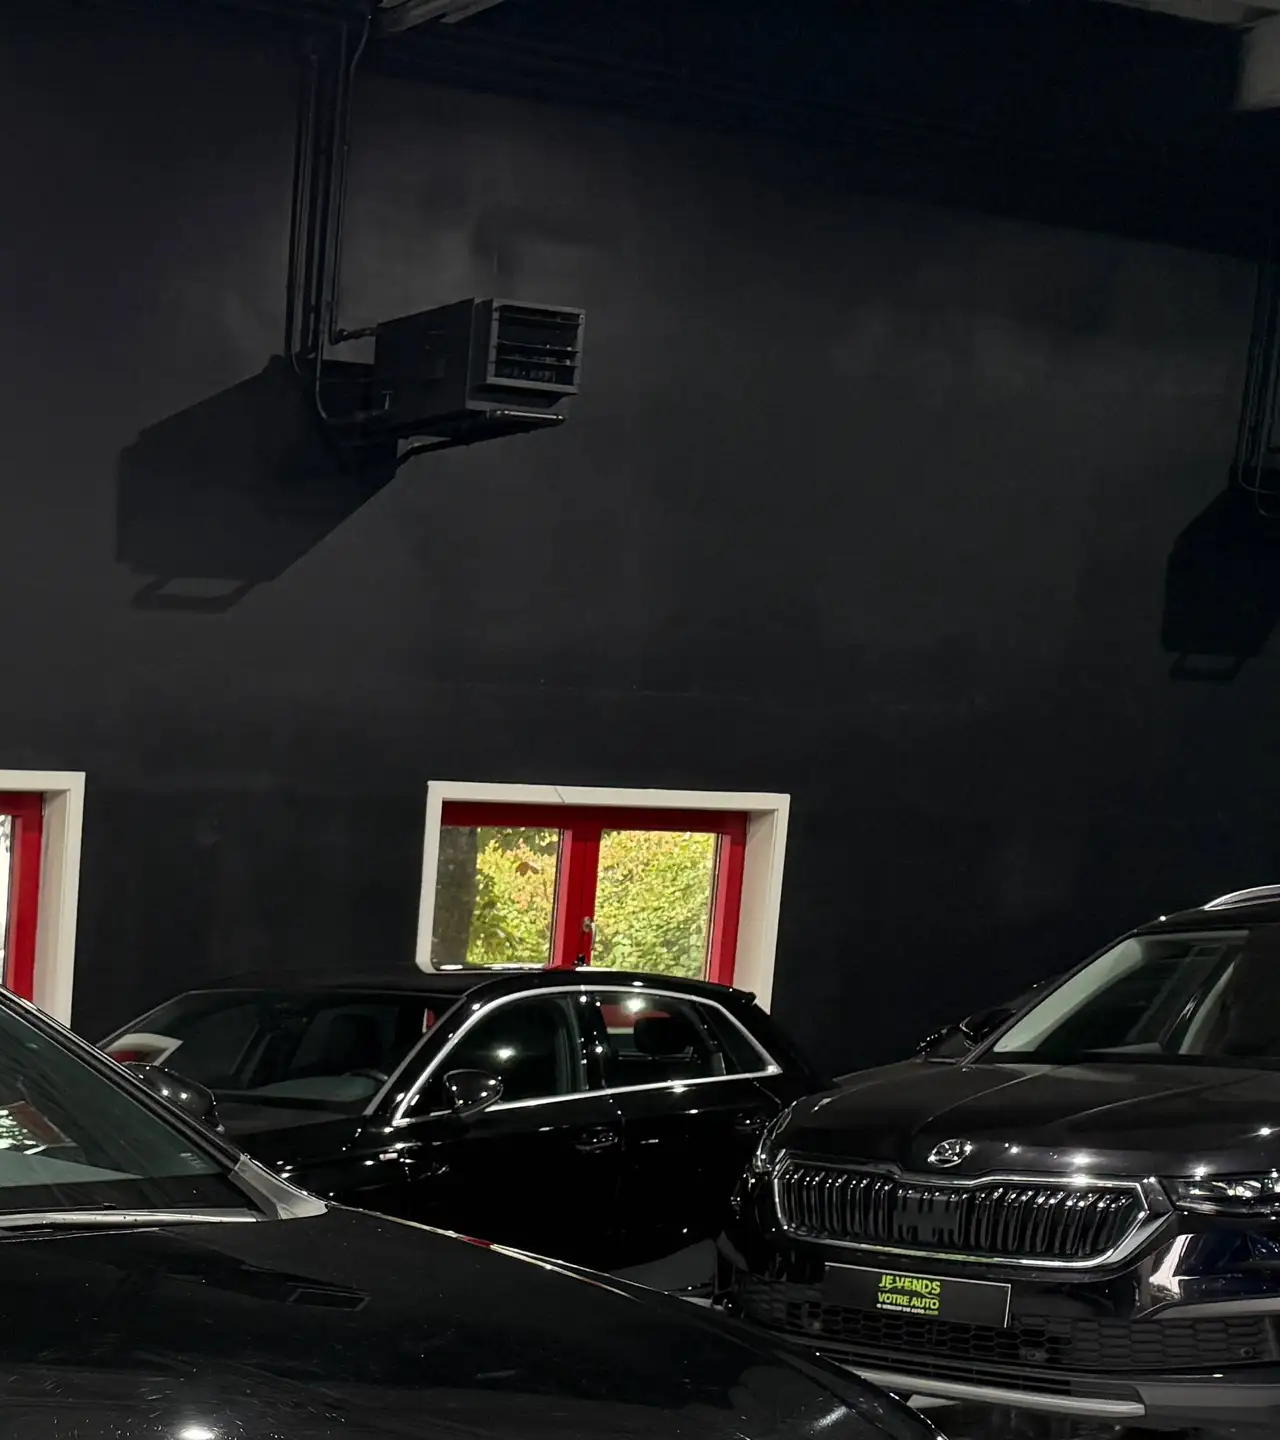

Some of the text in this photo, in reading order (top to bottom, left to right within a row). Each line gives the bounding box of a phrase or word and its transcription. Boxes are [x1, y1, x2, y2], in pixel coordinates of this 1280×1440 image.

[895, 1276, 941, 1294] VENDS
[878, 1292, 910, 1306] VOTRE
[910, 1296, 940, 1310] AUTO
